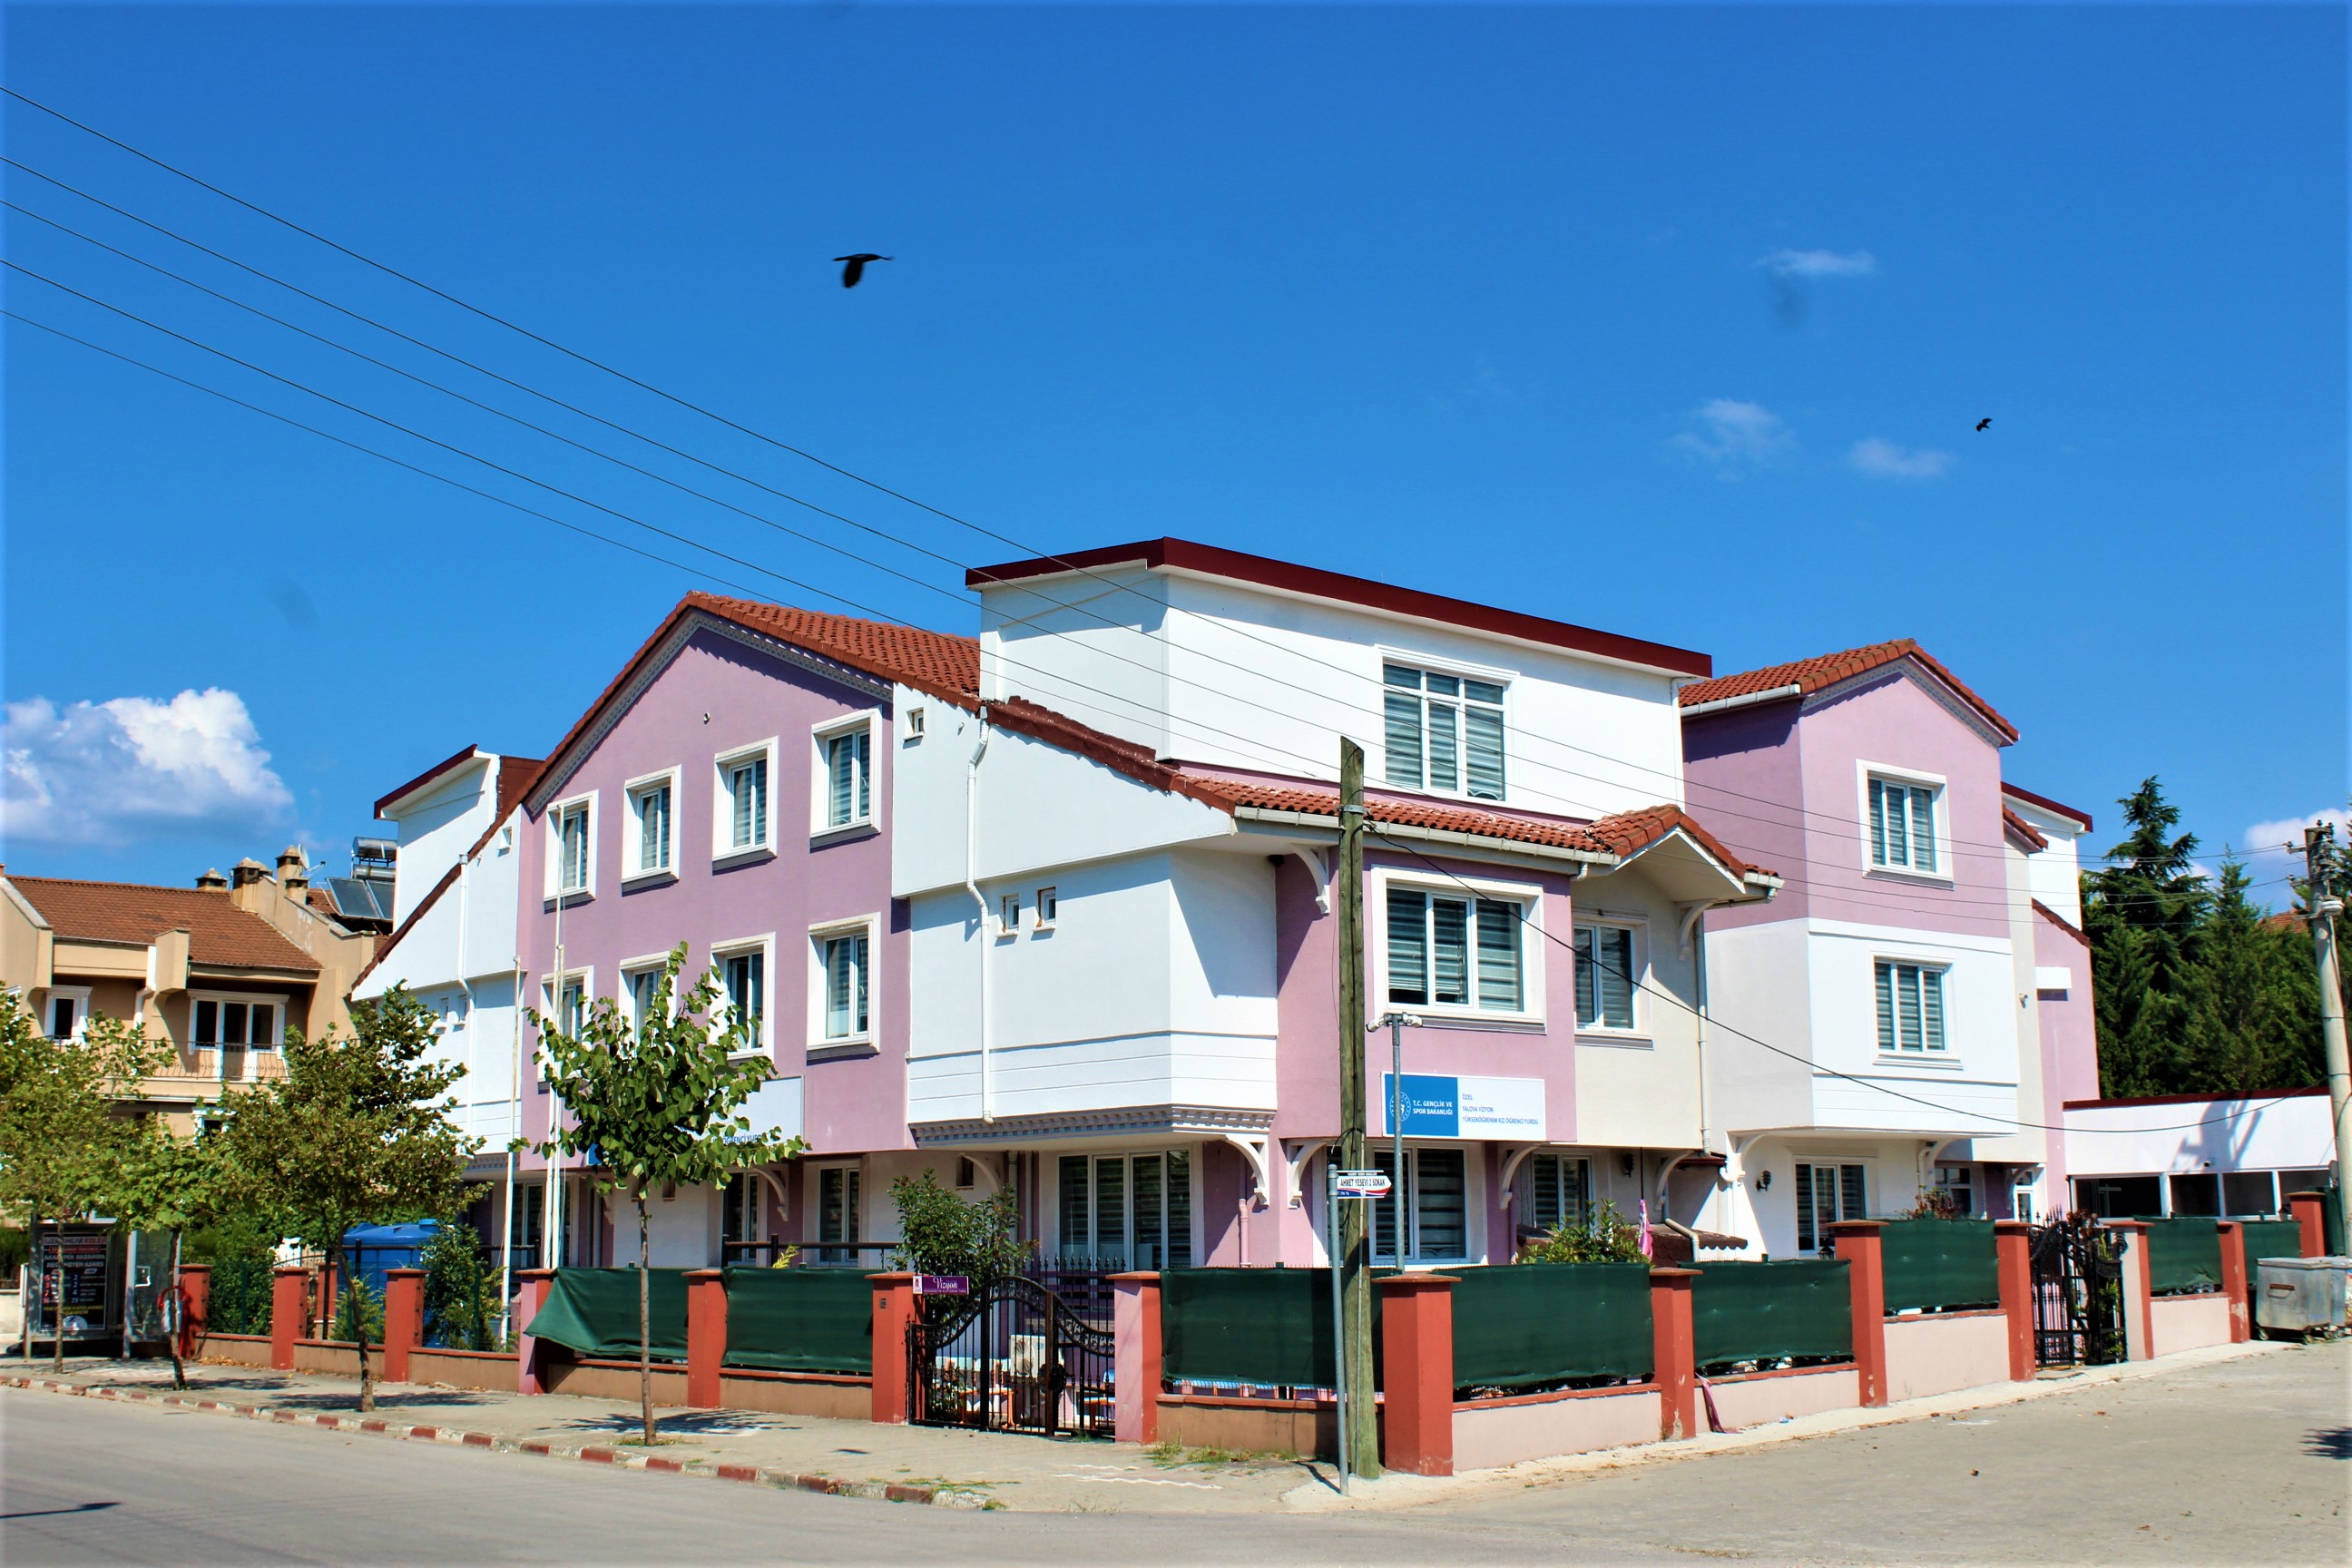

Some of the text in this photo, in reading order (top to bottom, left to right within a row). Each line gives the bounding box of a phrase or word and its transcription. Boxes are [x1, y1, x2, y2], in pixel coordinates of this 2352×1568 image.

[1423, 1100, 1445, 1108] GENÇLİK
[1340, 1178, 1354, 1187] AHMET
[1372, 1178, 1386, 1187] SOKAK
[933, 1277, 958, 1291] Vizyon
